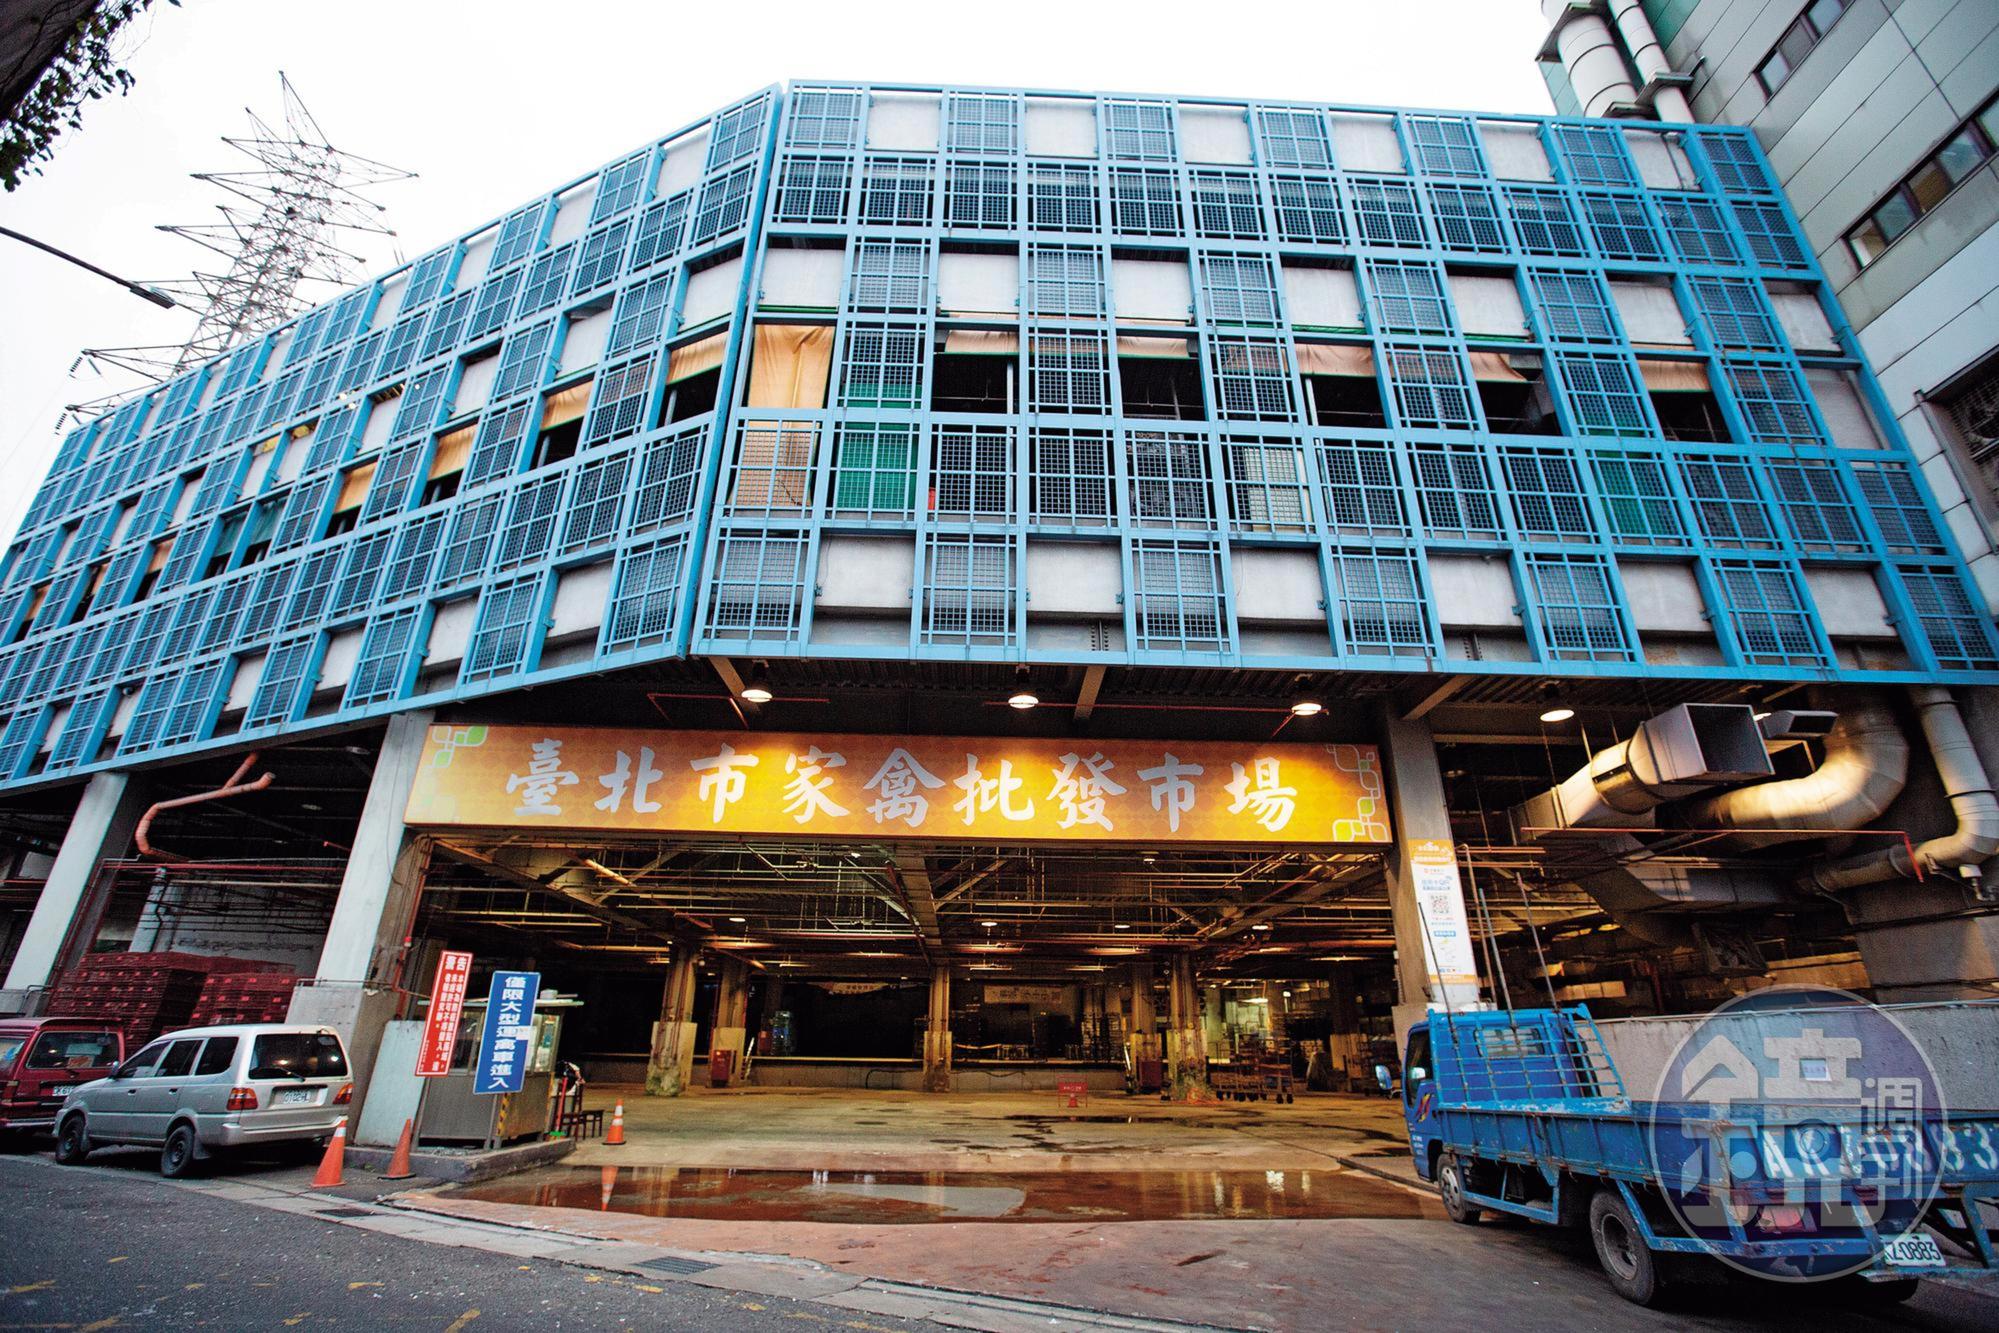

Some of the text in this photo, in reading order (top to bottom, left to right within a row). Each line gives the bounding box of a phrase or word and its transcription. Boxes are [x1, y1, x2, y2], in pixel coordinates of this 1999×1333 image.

[505, 739, 1299, 834] 臺北市家禽批發市場
